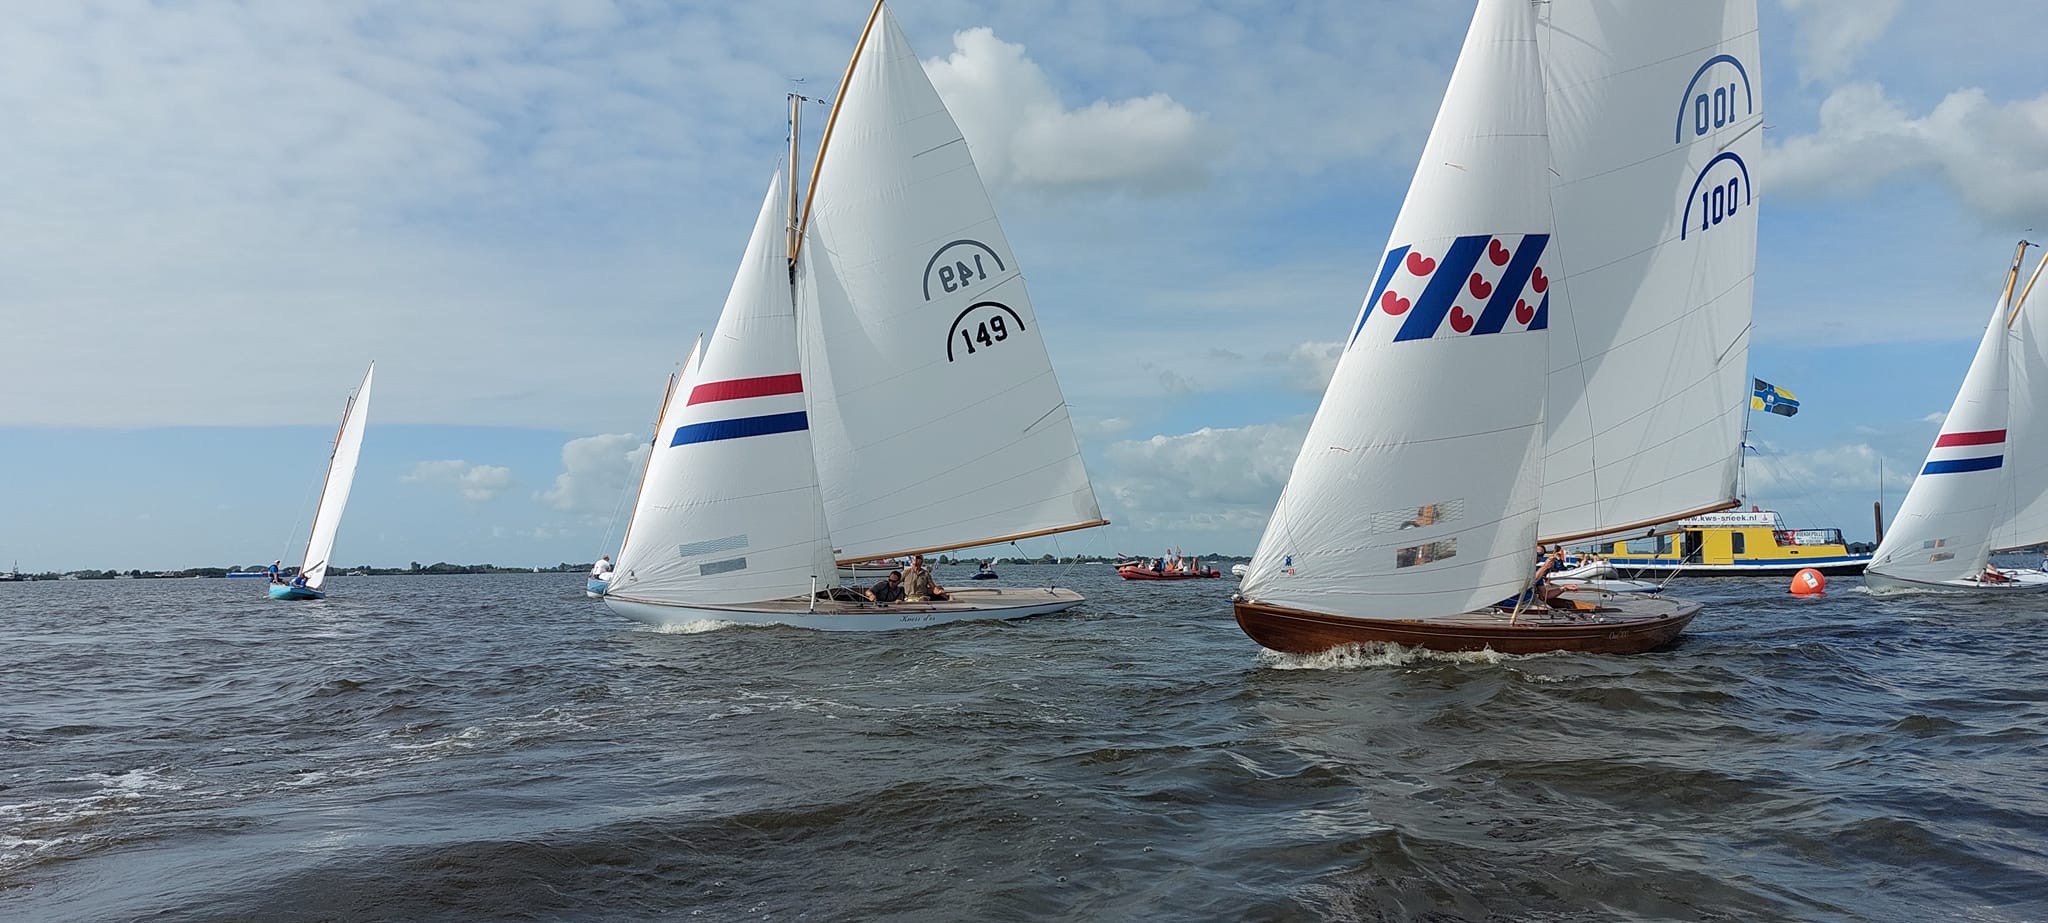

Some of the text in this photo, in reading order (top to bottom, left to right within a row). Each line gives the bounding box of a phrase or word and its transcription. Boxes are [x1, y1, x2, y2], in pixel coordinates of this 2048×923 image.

[1702, 177, 1739, 231] 100
[961, 315, 1008, 354] 149
[1680, 514, 1757, 522] ww.kws-sneek.nl
